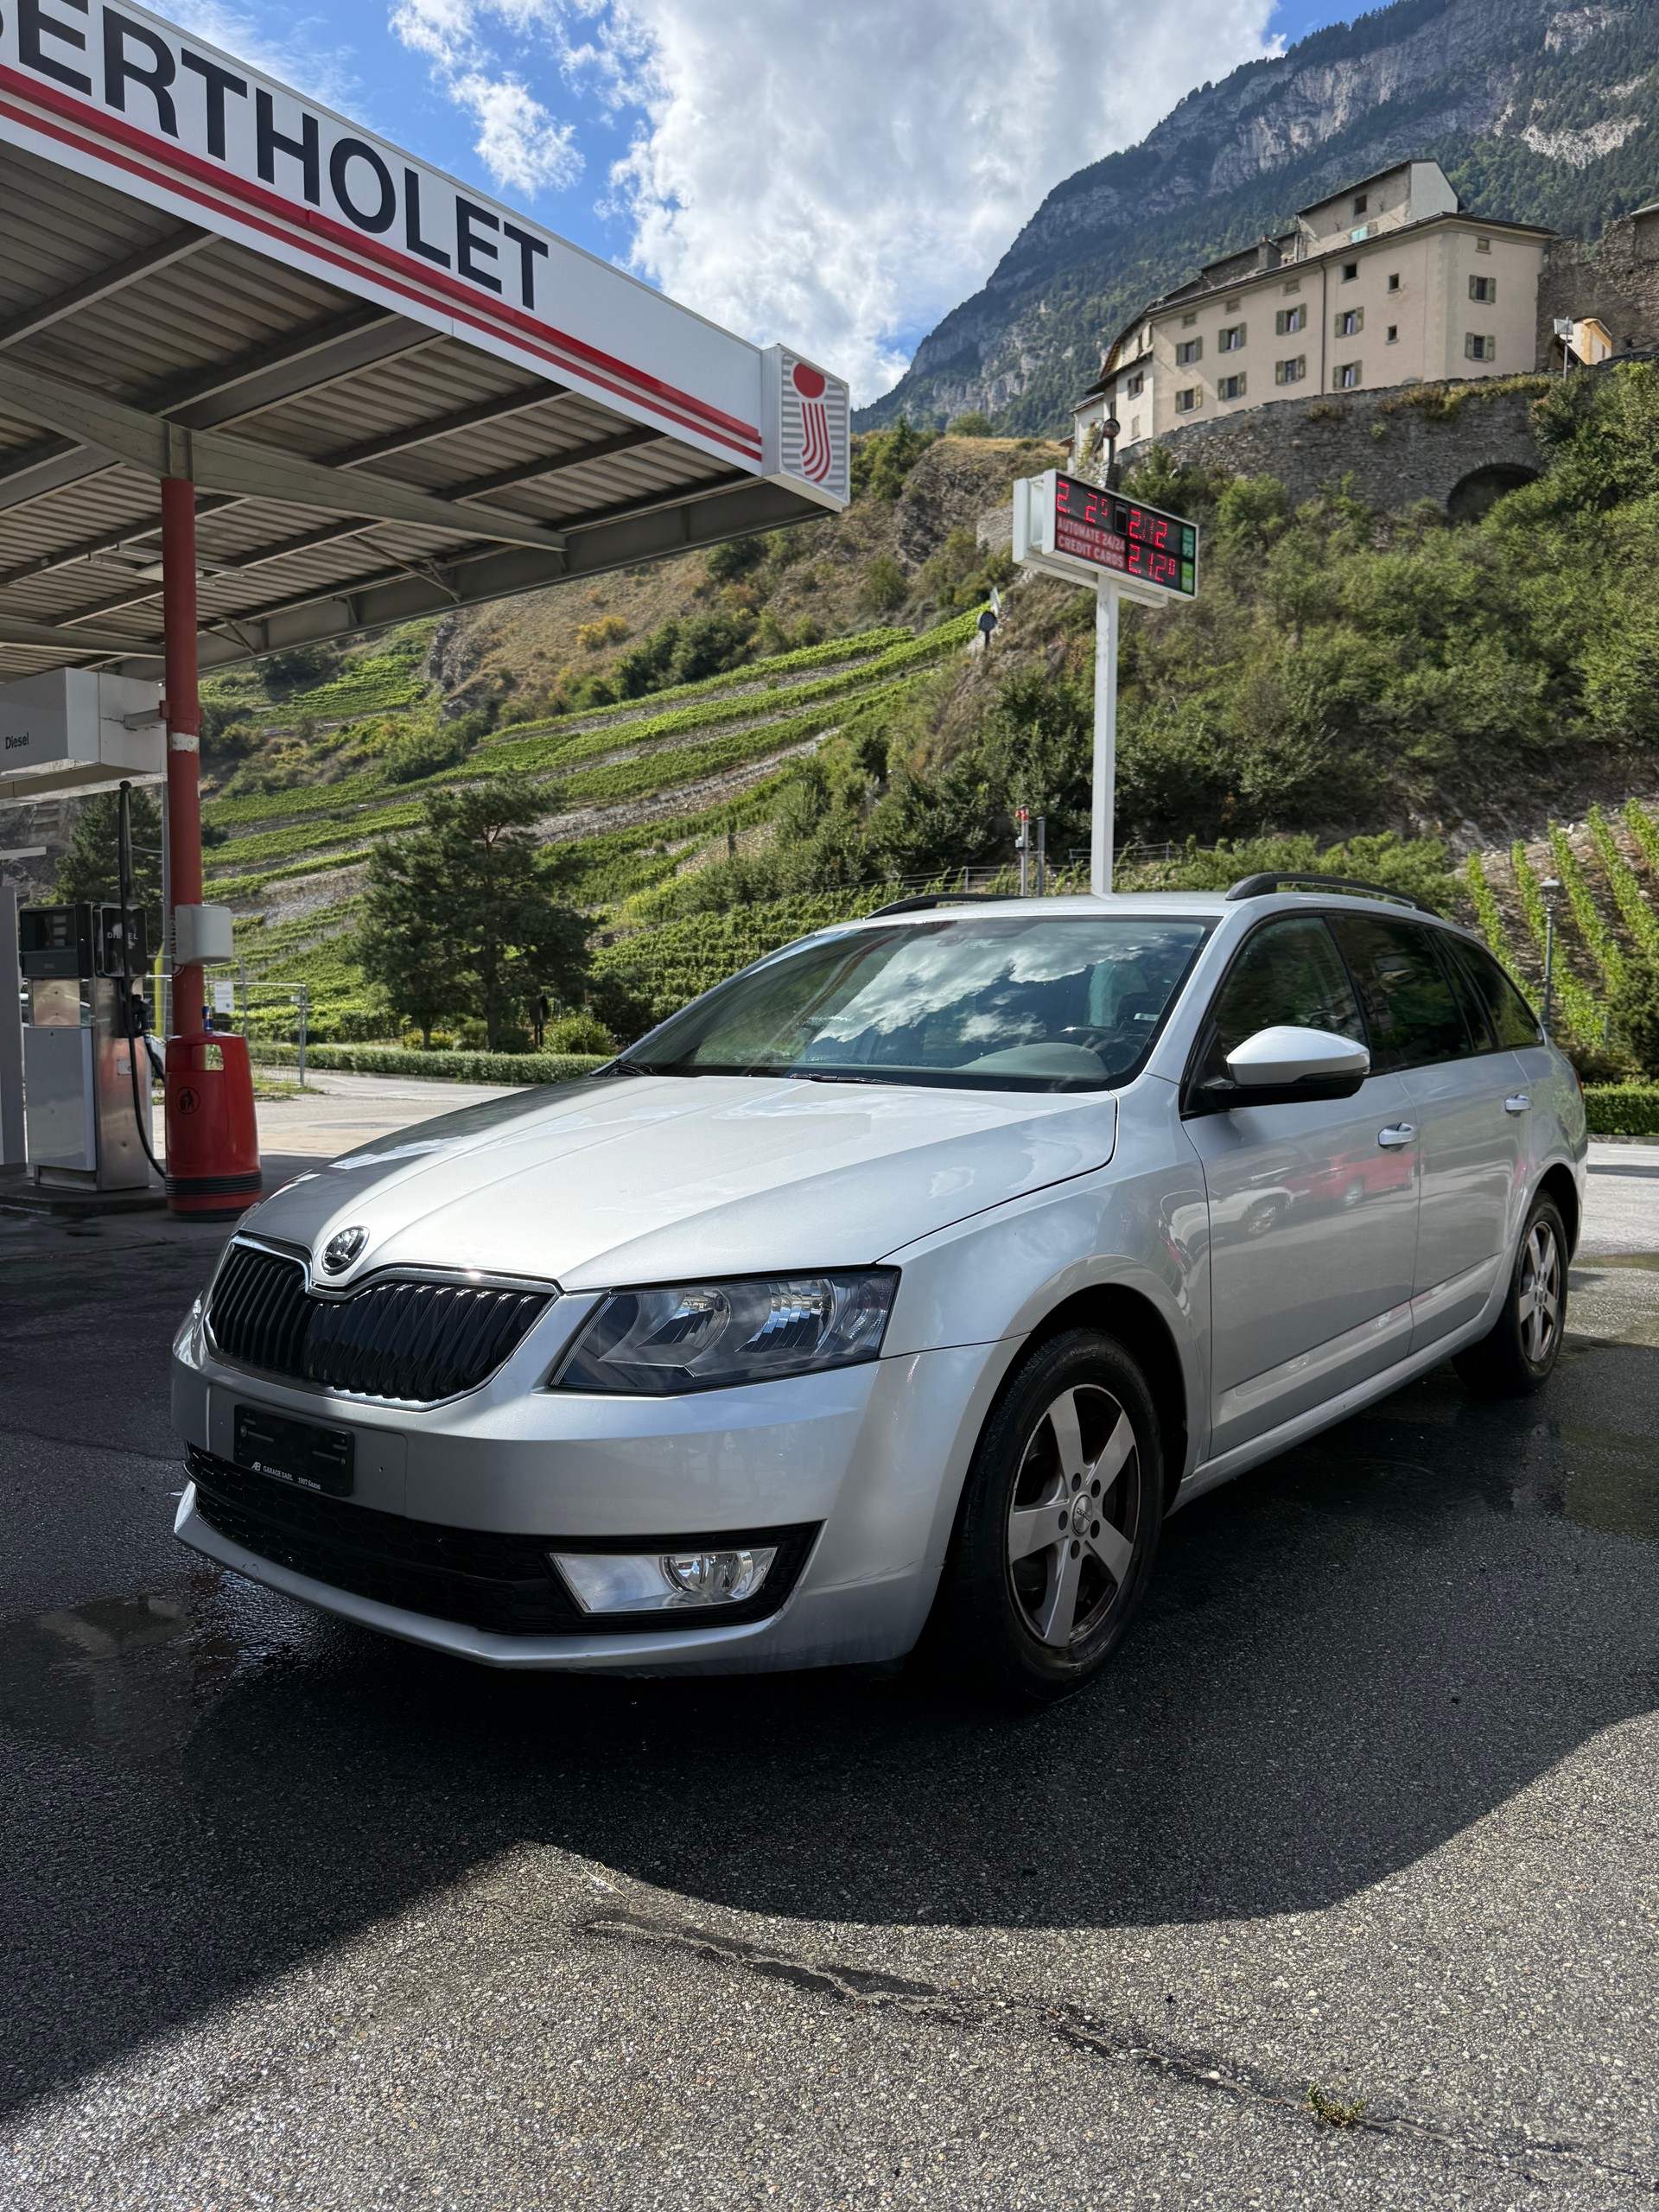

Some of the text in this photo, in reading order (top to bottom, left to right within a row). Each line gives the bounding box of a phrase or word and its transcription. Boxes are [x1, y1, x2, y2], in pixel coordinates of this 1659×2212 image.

[0, 0, 549, 311] ERTHOLET
[1057, 516, 1126, 552] AUTOMATE 24/24
[1058, 535, 1126, 569] CREDIT CARDS
[1182, 542, 1194, 558] 95
[4, 732, 29, 750] Diesel
[107, 931, 138, 940] DIEEL
[263, 1465, 282, 1478] GARAGE
[282, 1471, 294, 1481] SARL
